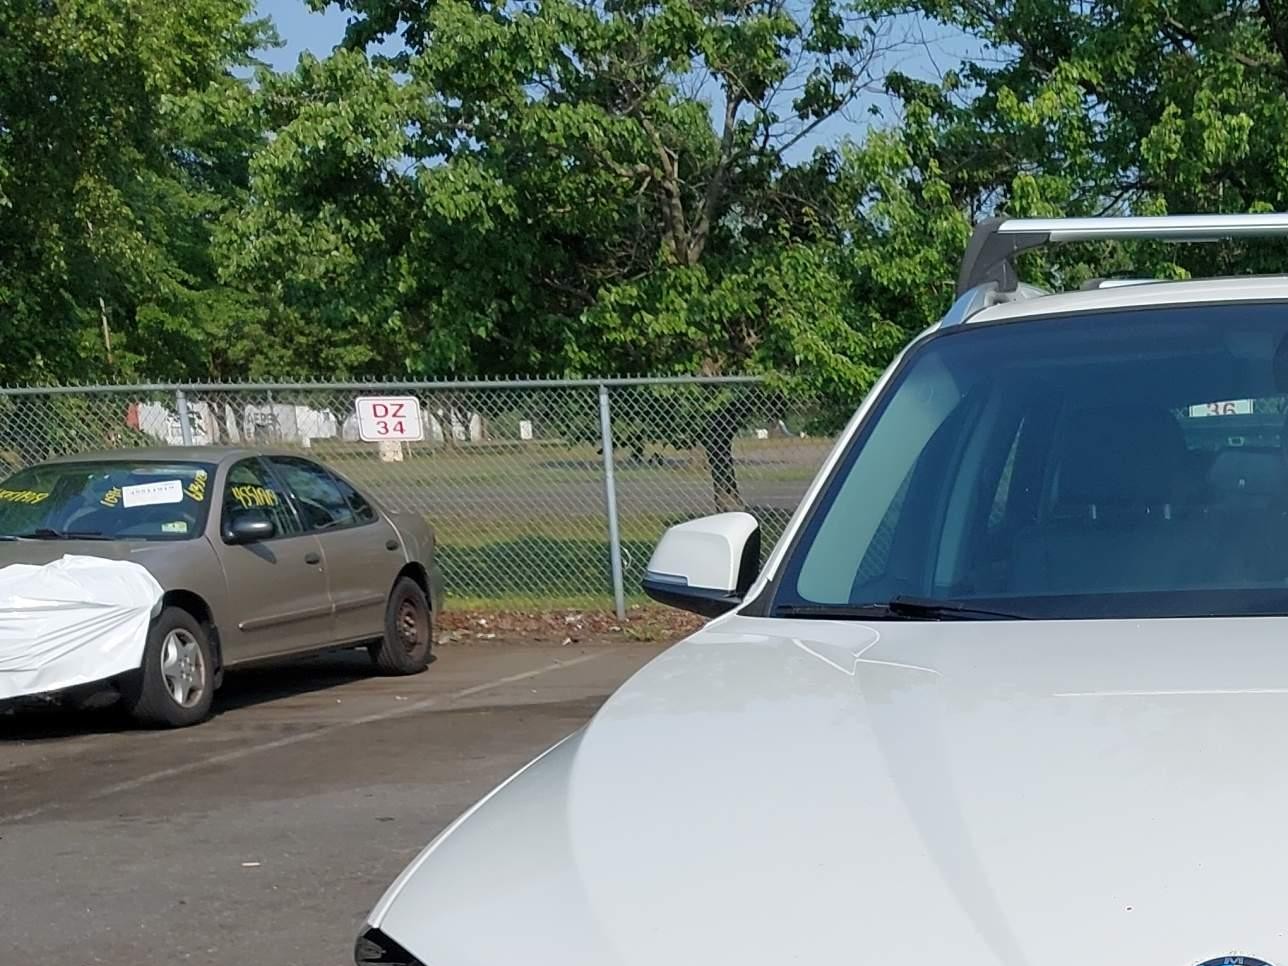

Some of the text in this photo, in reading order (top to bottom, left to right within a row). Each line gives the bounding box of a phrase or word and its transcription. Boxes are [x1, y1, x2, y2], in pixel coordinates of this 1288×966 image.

[372, 403, 407, 418] DZ
[1207, 402, 1235, 416] 36
[375, 420, 407, 436] 34
